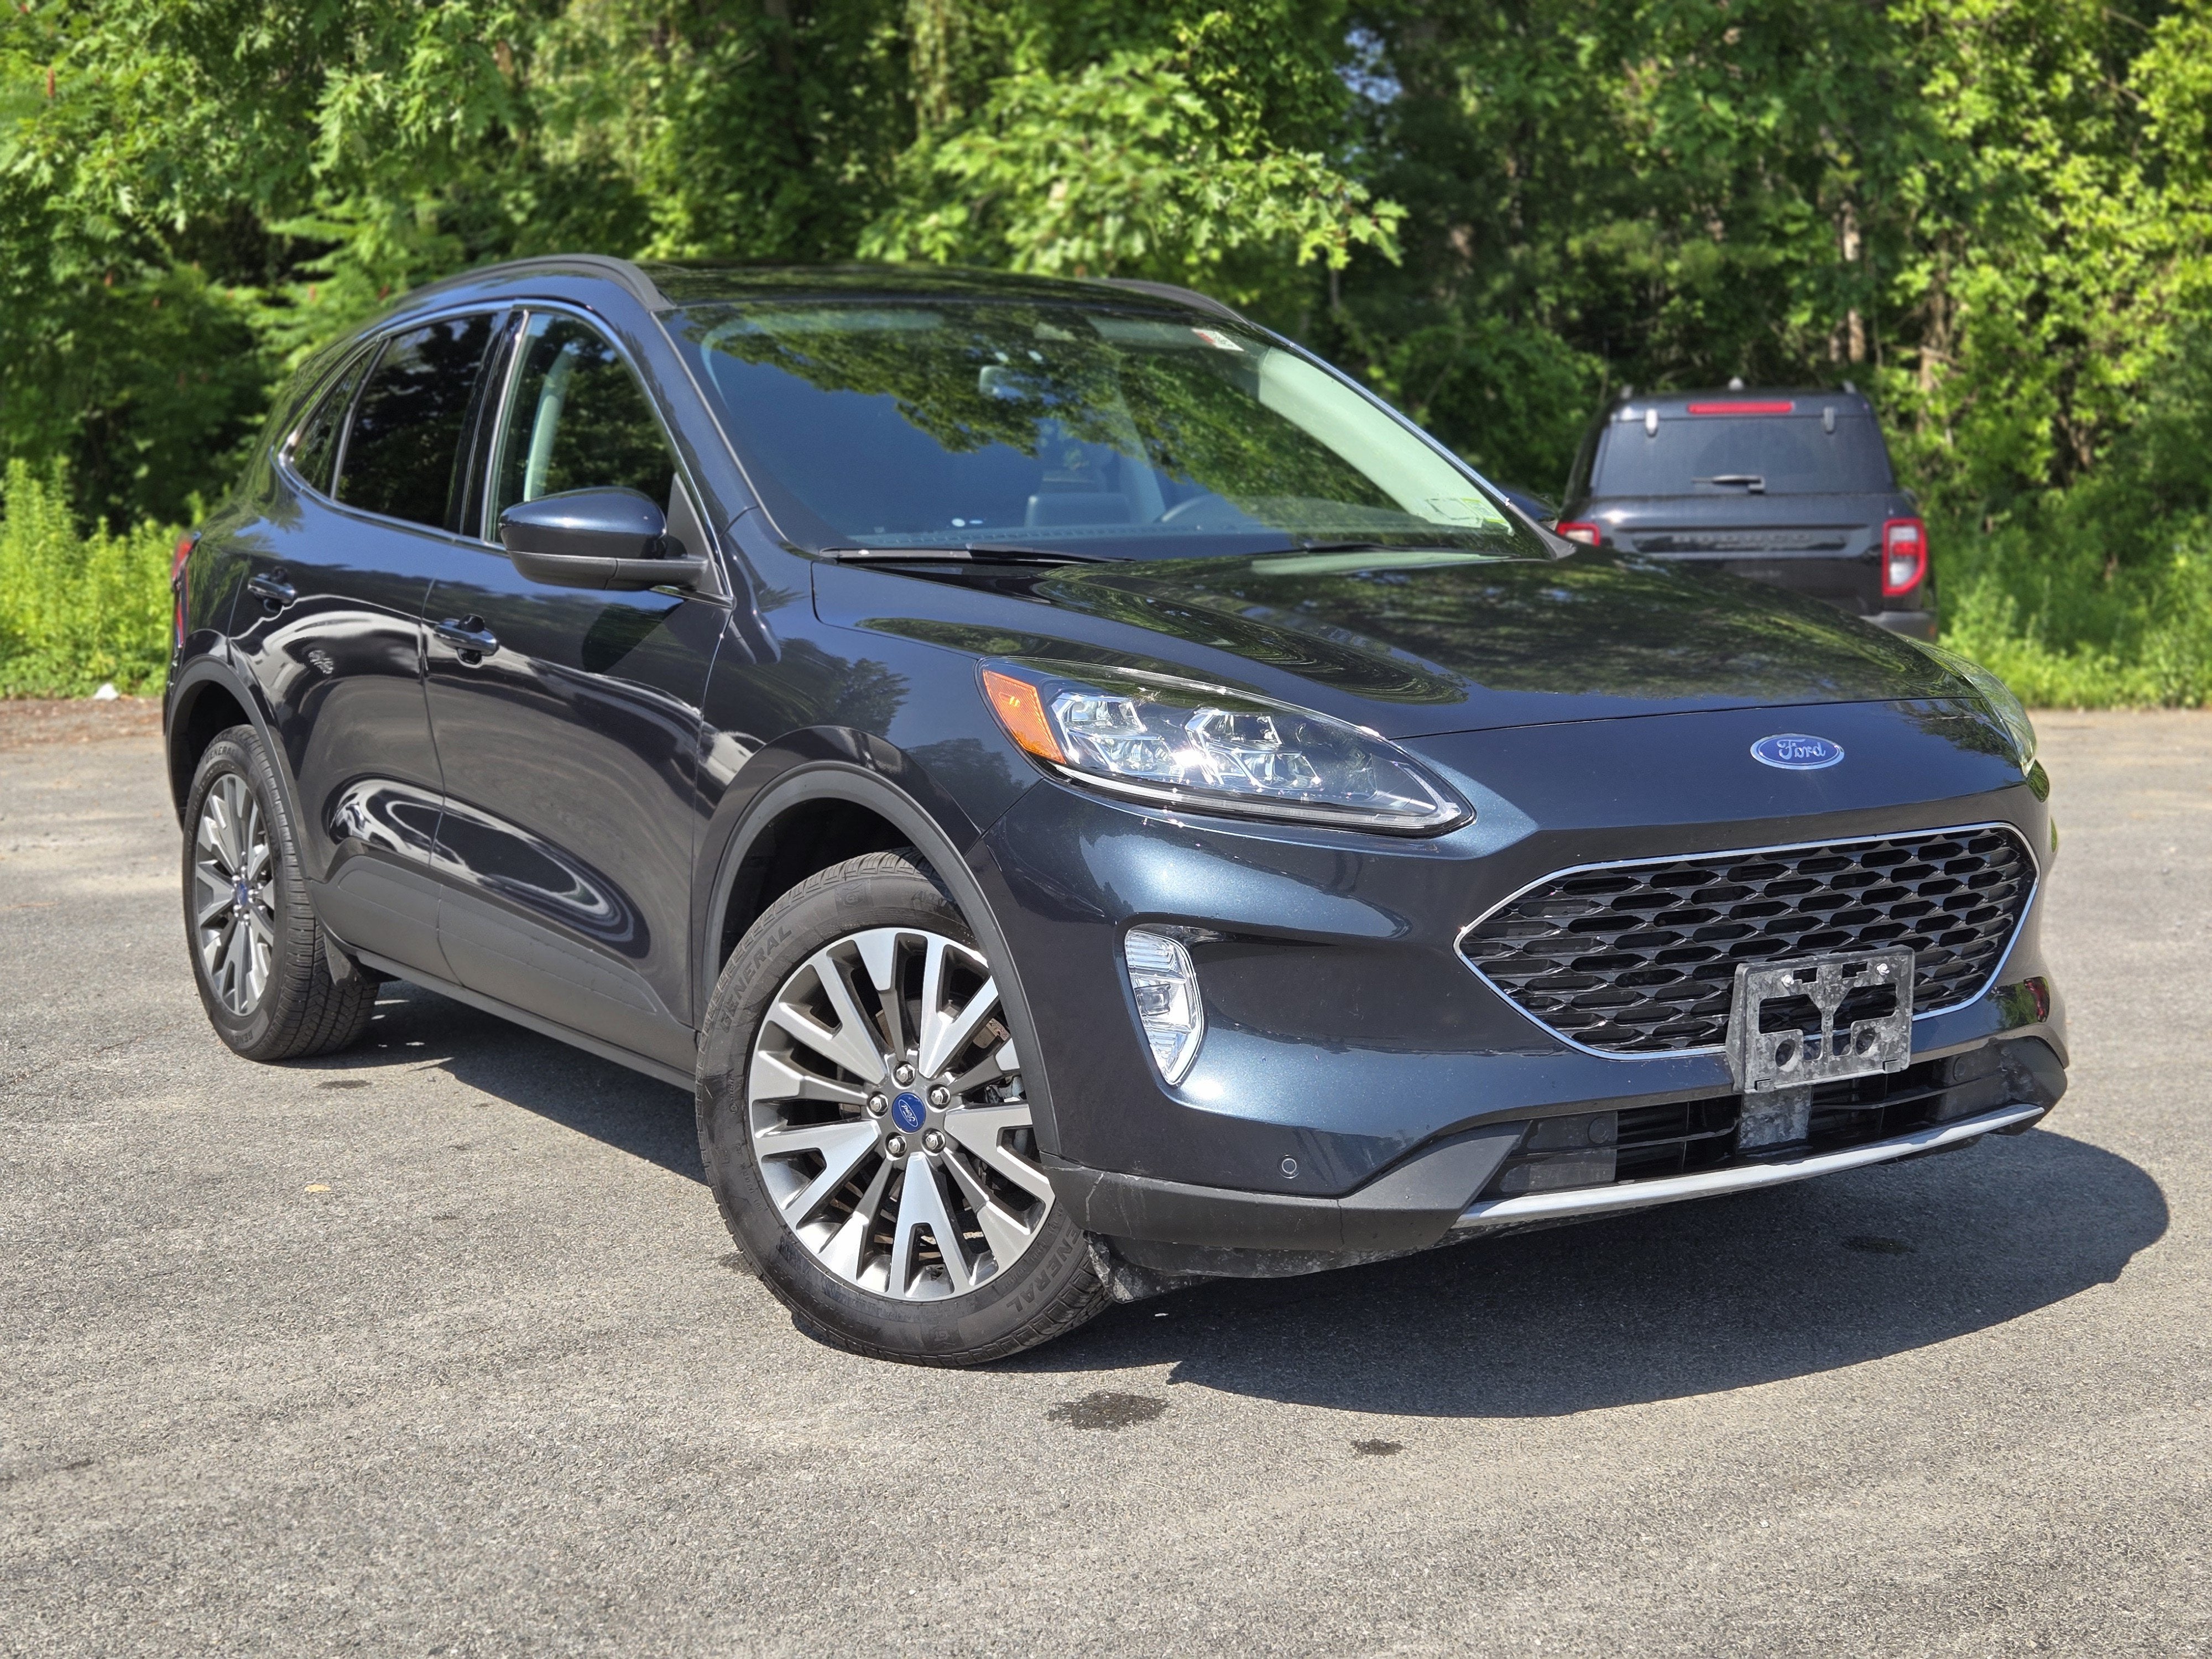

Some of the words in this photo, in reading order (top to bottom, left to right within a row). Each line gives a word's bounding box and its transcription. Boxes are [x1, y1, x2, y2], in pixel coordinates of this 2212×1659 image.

[1776, 739, 1826, 760] Ford
[720, 926, 792, 1034] GENERAL
[900, 1104, 916, 1122] Ford
[1006, 1221, 1083, 1313] ENERAL
